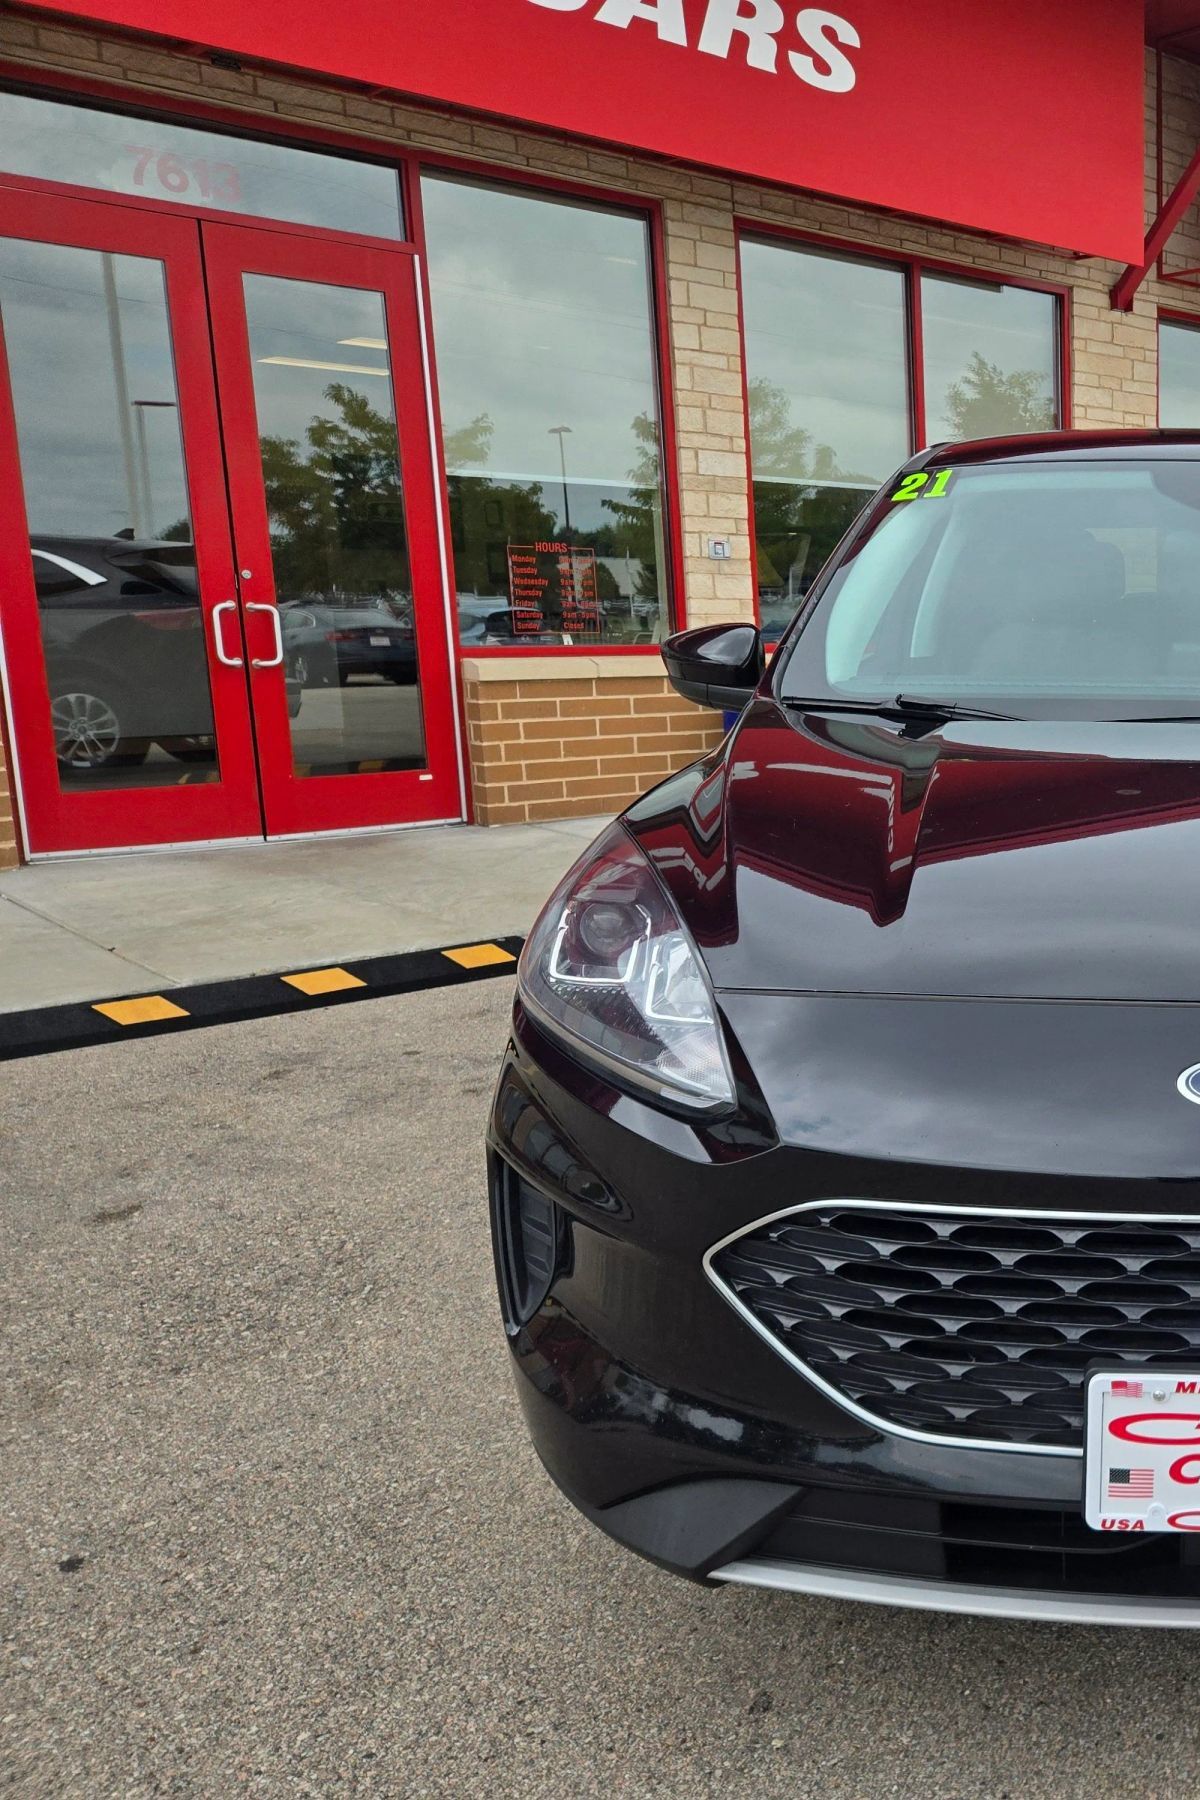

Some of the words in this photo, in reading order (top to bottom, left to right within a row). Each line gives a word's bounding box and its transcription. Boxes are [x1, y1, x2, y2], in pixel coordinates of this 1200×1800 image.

[524, 0, 861, 93] ARS
[121, 143, 241, 204] 7613
[891, 468, 953, 502] 21
[535, 541, 568, 553] HOURS
[511, 555, 536, 565] Monday
[512, 566, 537, 575] Tuesday
[513, 577, 548, 587] Wednesday
[514, 588, 543, 597] Thursday
[515, 600, 535, 608] Friday
[516, 611, 544, 619] Saturday
[517, 622, 540, 630] Sunday
[1101, 1518, 1146, 1531] USA
